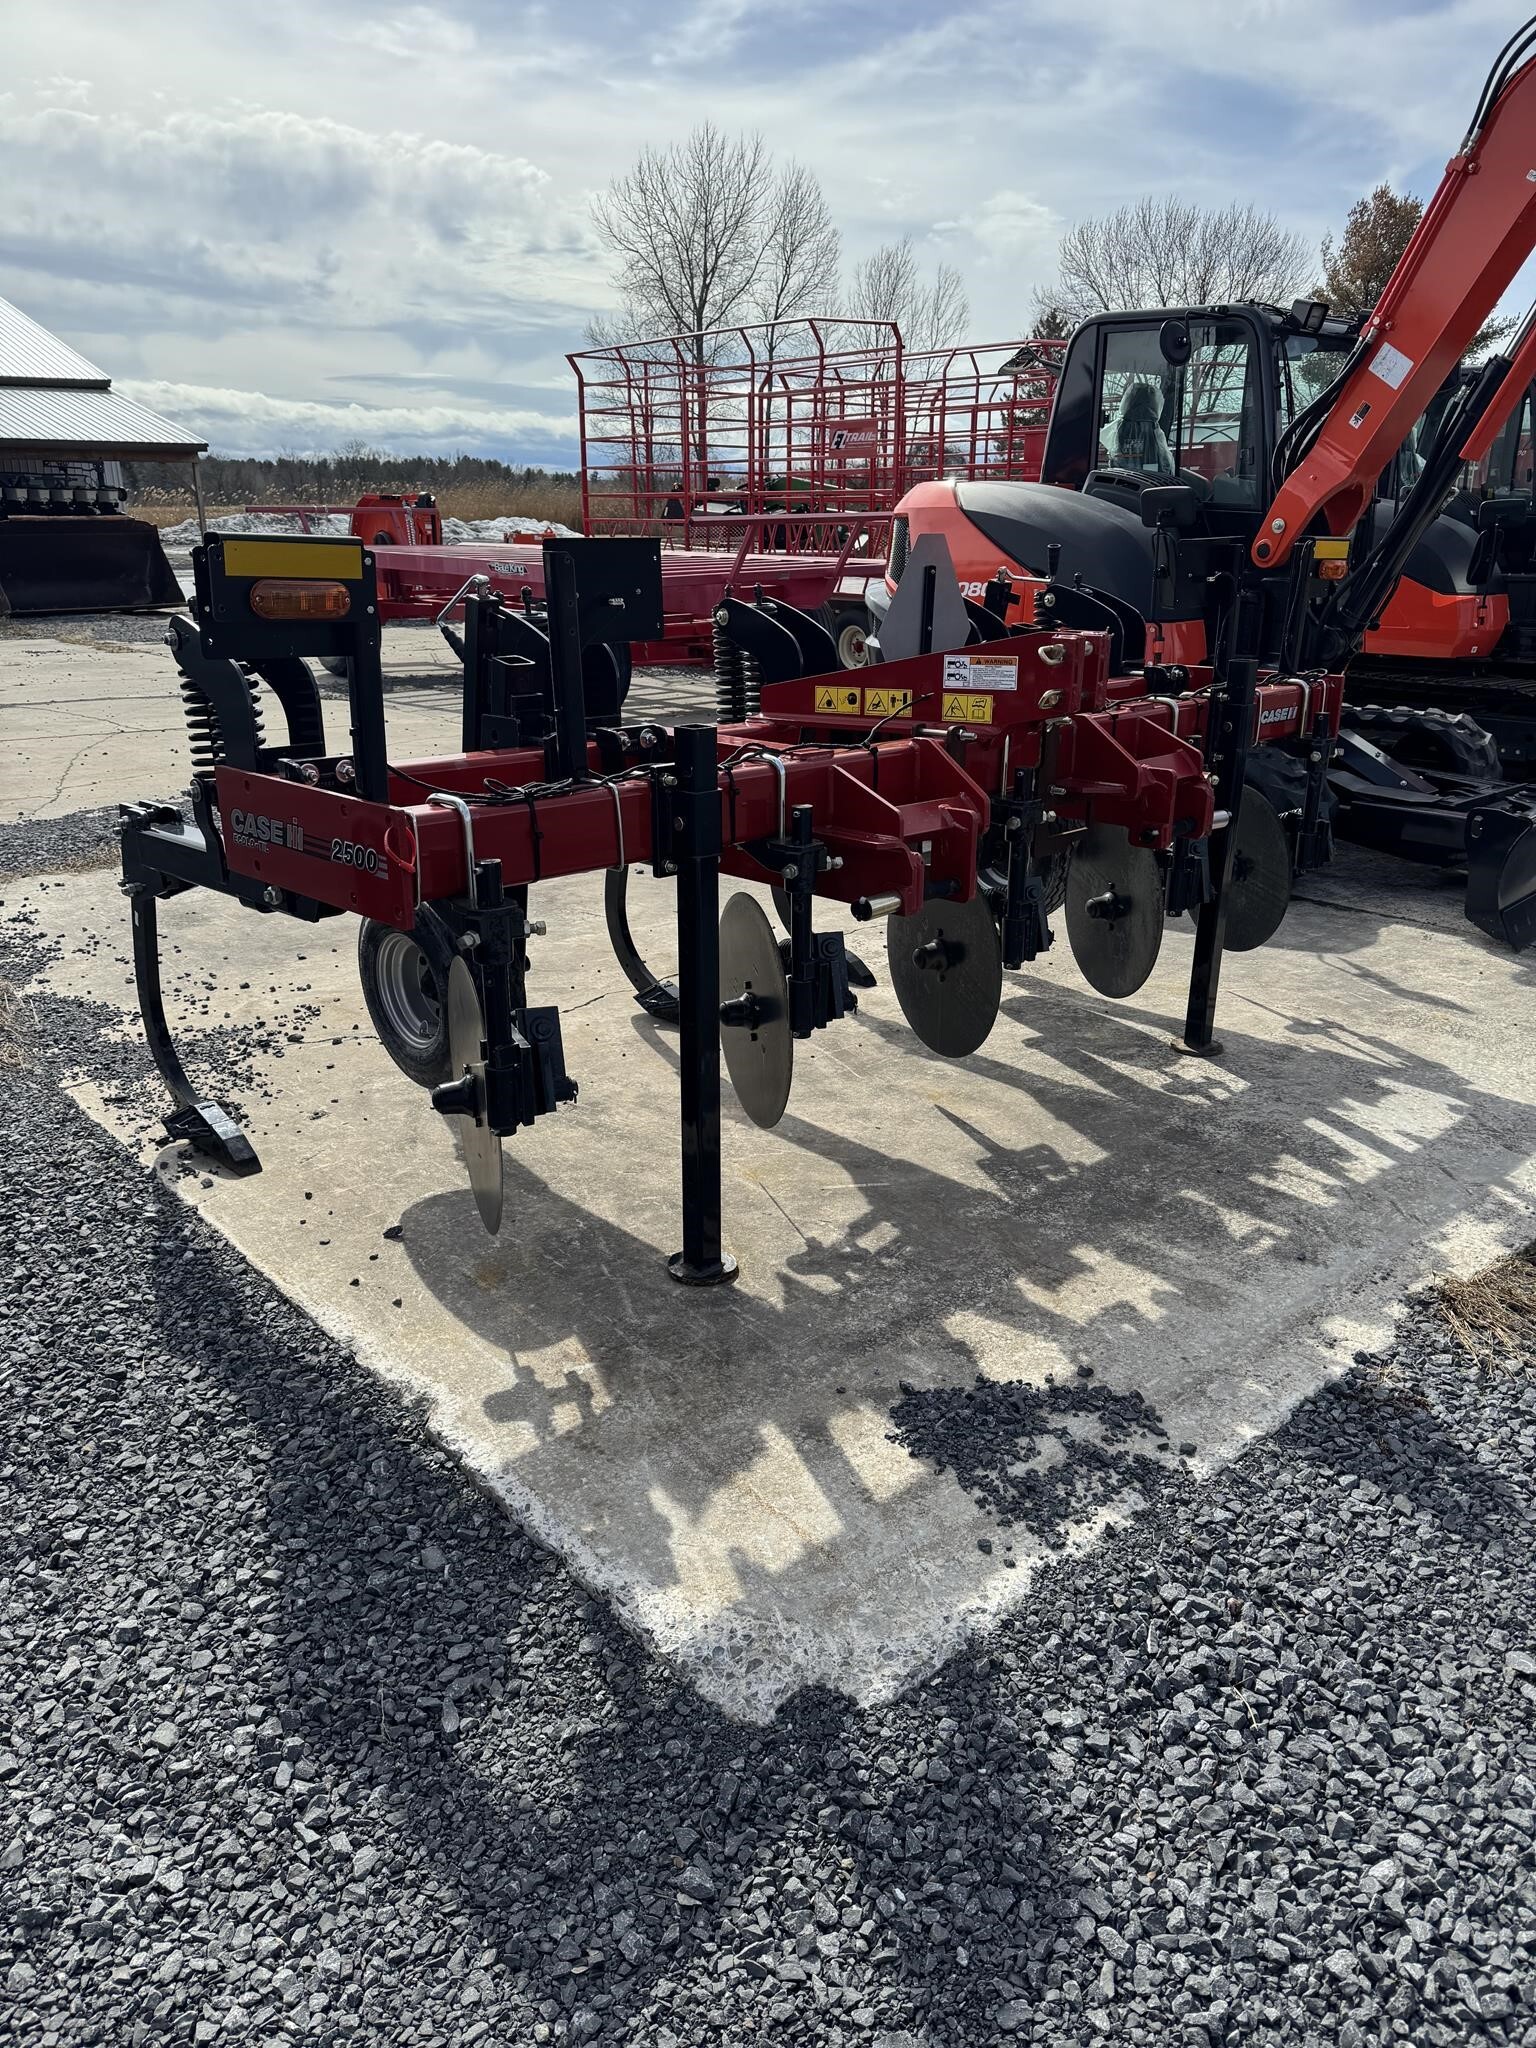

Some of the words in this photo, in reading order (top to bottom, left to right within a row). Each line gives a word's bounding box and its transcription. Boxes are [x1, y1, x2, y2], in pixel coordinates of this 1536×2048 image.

[846, 432, 876, 442] TRAIL
[1261, 707, 1288, 723] CASE
[231, 808, 283, 845] CASE
[331, 838, 378, 874] 2500
